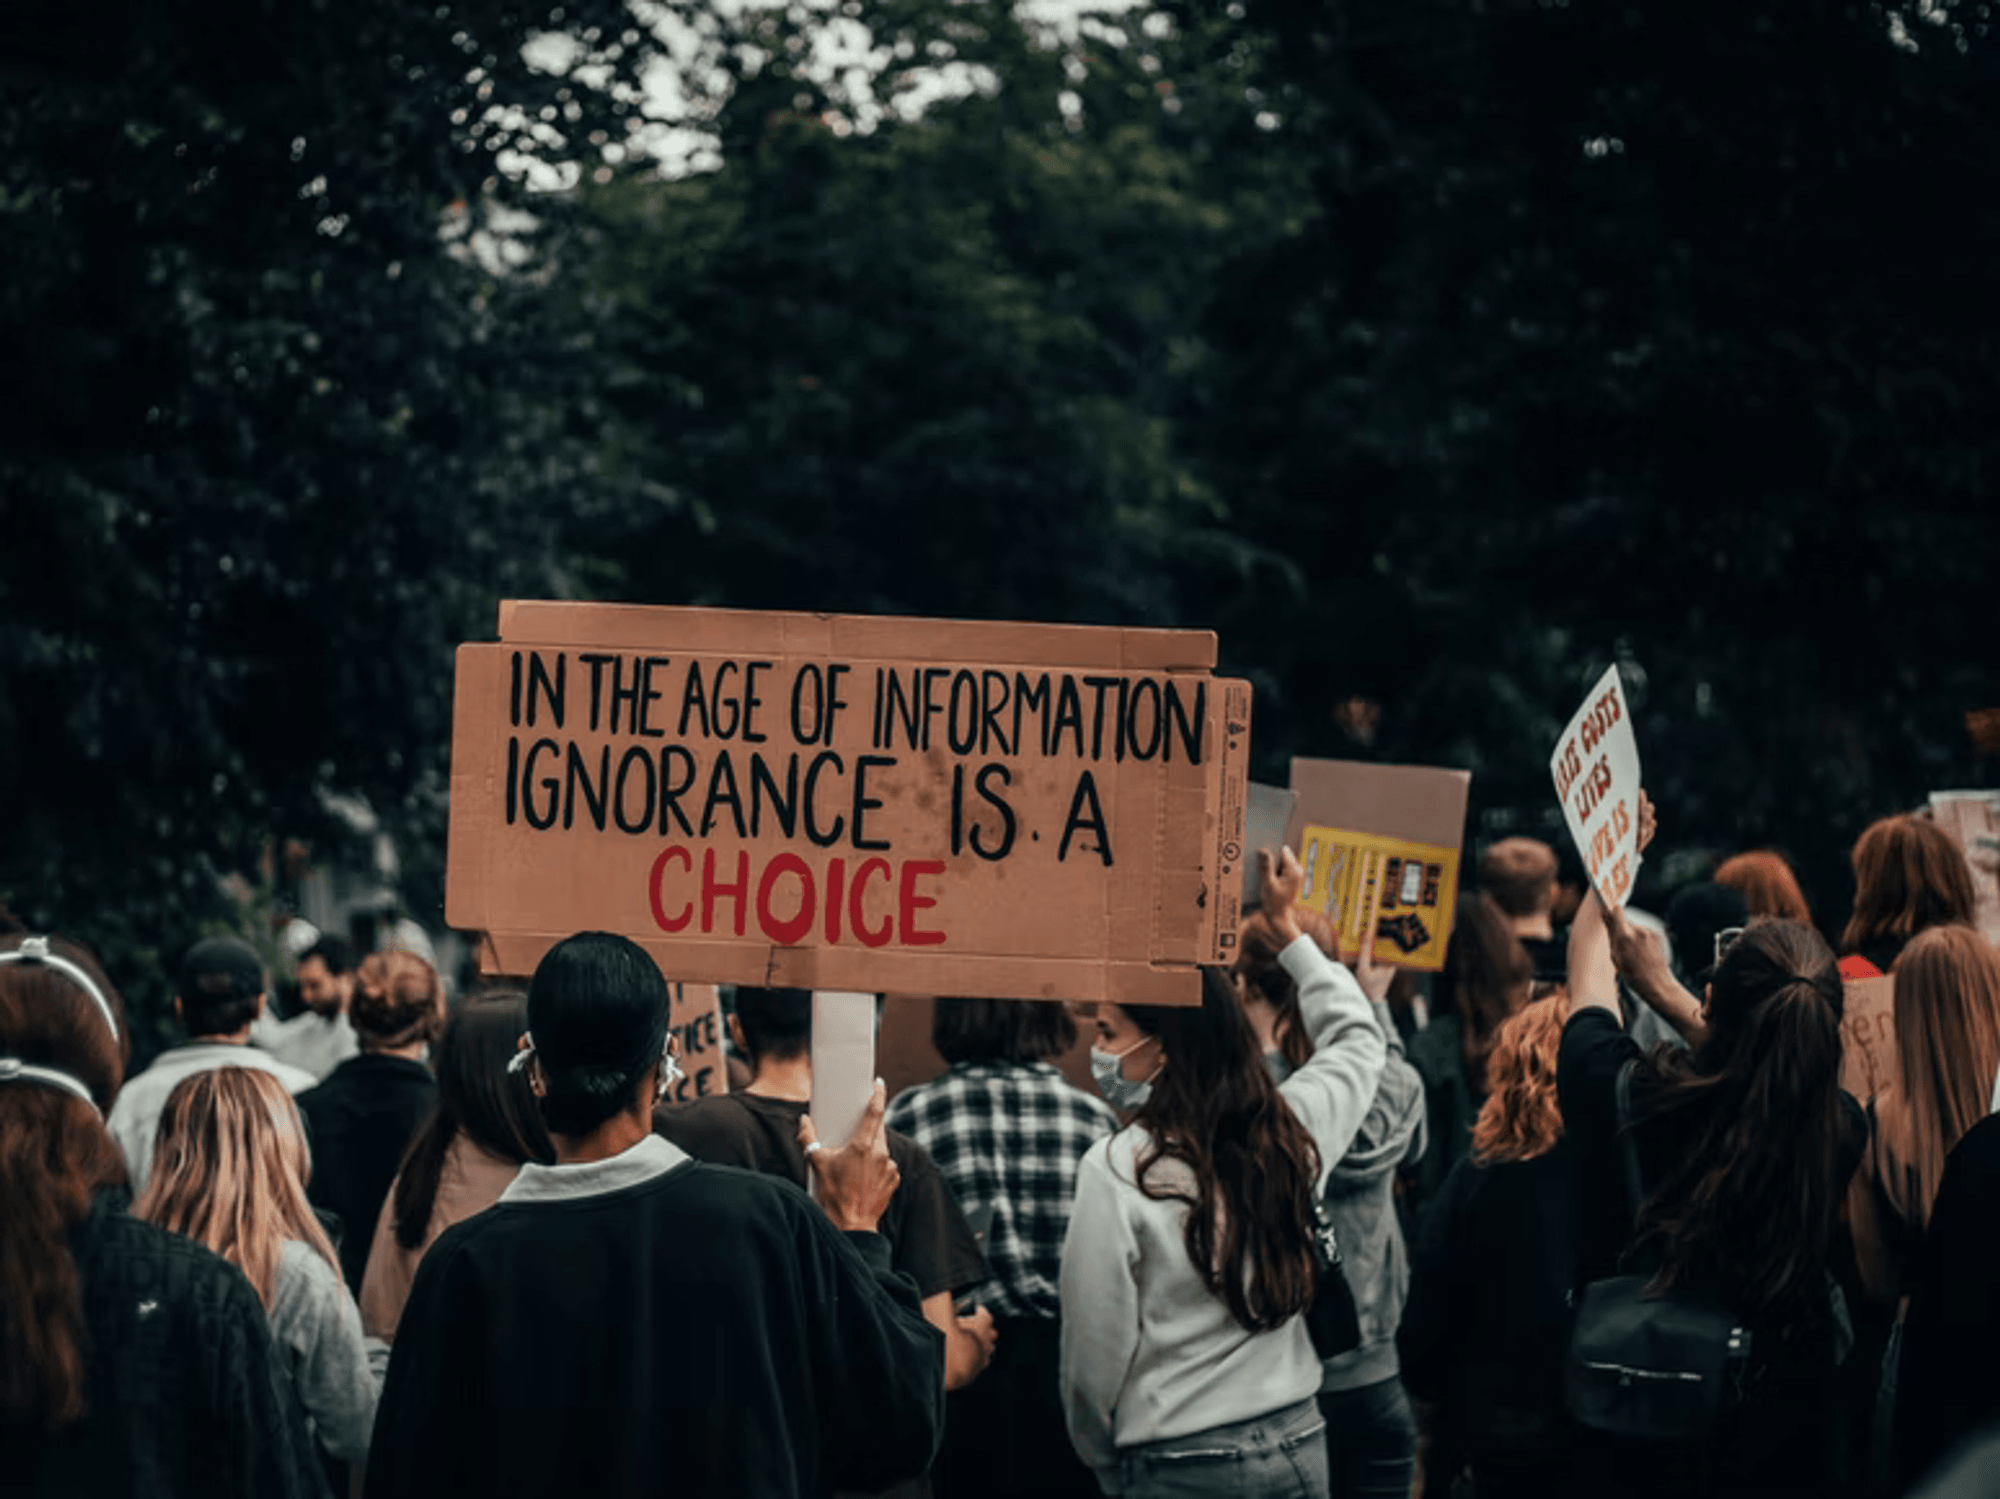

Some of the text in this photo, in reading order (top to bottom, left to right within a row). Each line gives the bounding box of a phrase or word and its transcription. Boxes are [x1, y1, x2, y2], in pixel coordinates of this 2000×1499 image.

[510, 651, 565, 729] IN
[579, 653, 670, 738] THE
[677, 660, 773, 744] AGE
[790, 663, 851, 747] OF
[873, 668, 1206, 766] INFORMATION
[506, 736, 898, 852] IGNORANCE
[1058, 770, 1114, 867] A
[648, 844, 947, 948] CHOICE
